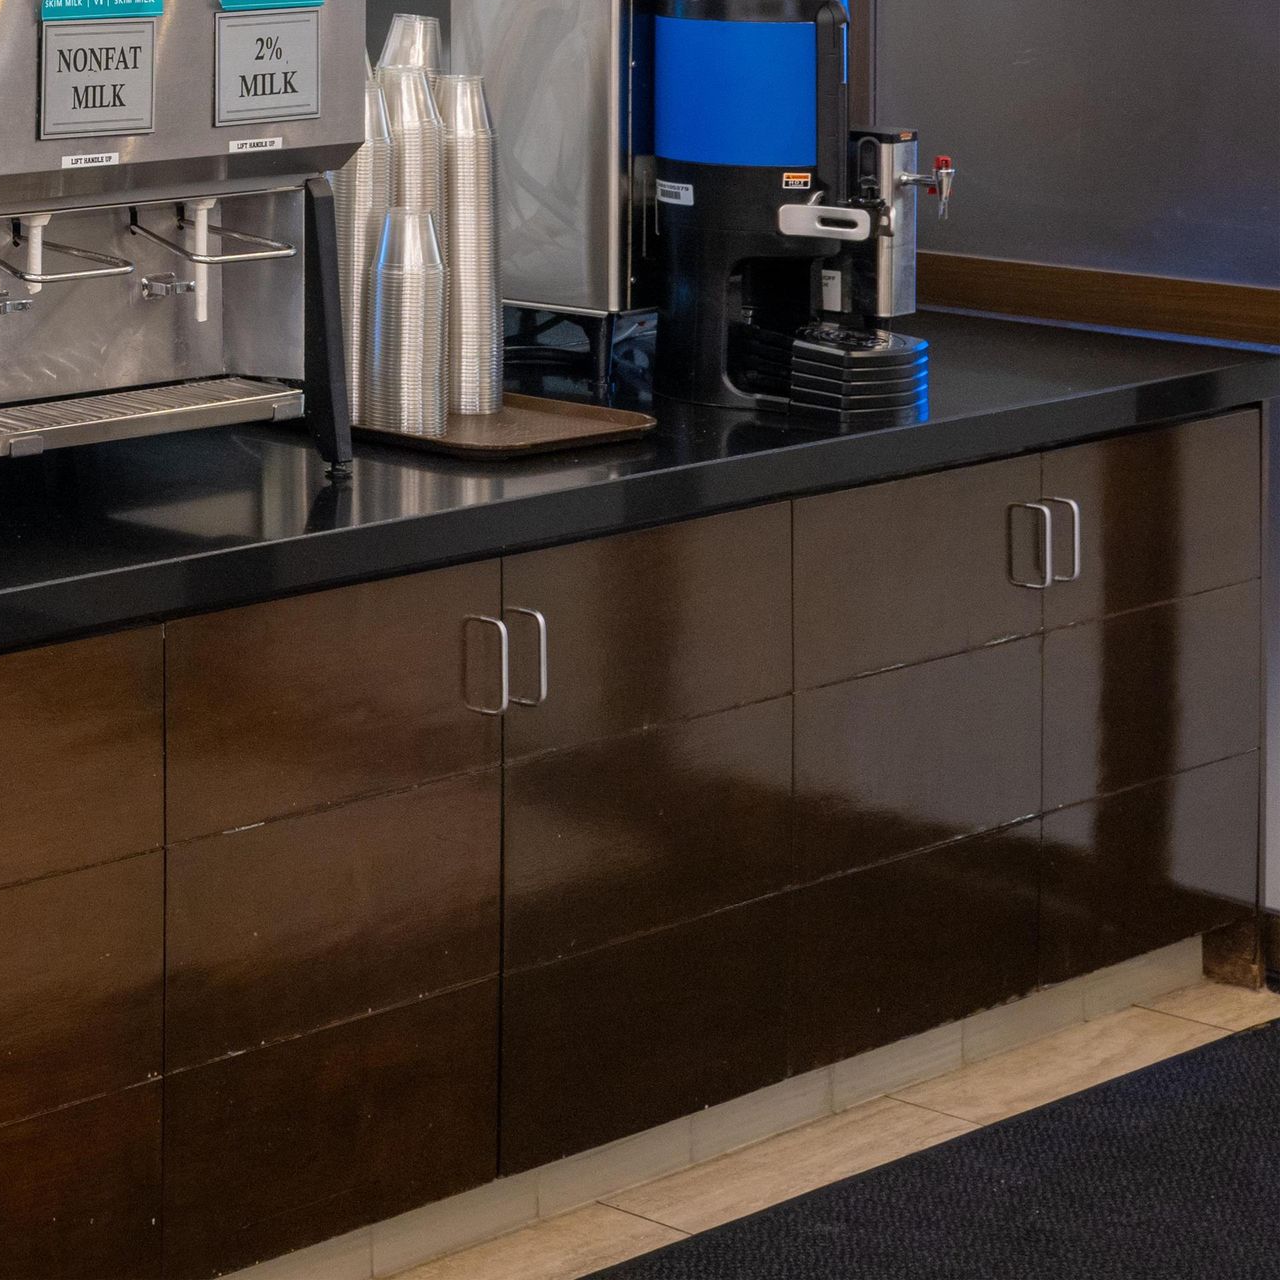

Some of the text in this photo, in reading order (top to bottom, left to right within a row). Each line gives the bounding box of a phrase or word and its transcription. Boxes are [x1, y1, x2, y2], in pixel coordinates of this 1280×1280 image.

[44, 0, 63, 9] SKIM
[56, 45, 142, 73] NONFAT
[254, 35, 283, 61] 2%
[71, 83, 126, 110] MILK
[238, 70, 299, 98] MILK
